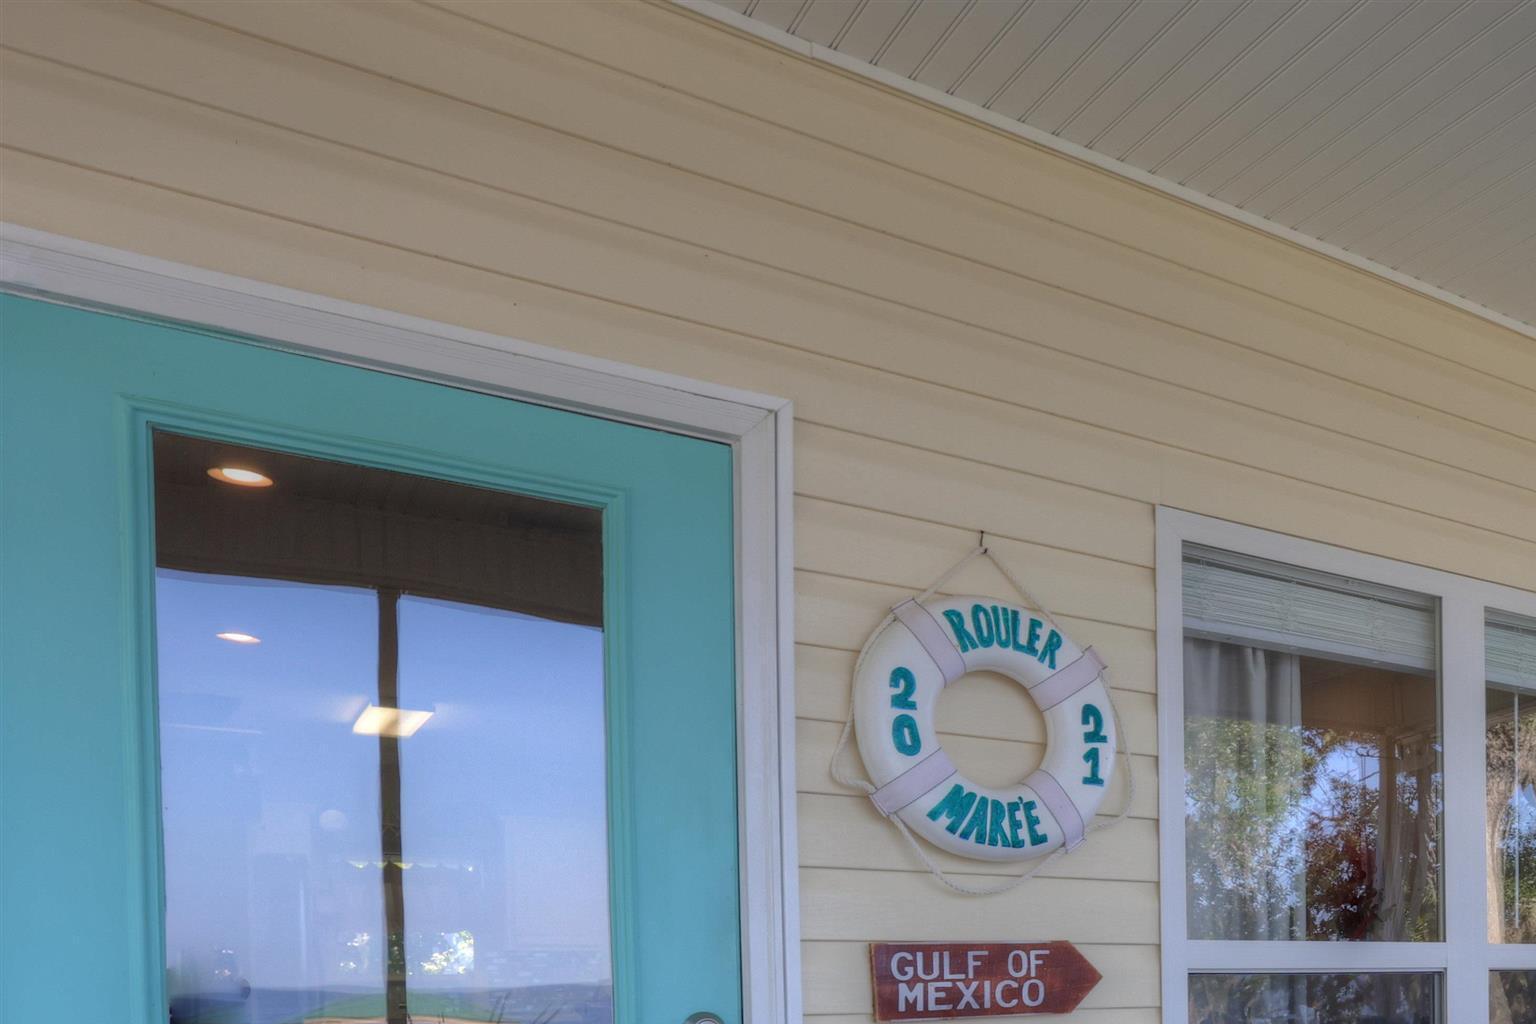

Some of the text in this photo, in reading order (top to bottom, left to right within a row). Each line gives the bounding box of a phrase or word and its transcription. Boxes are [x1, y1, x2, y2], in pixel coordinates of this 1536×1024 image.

[943, 604, 1063, 670] ROULER
[890, 949, 1050, 981] GULF OF
[898, 979, 1046, 1012] MEXICO
